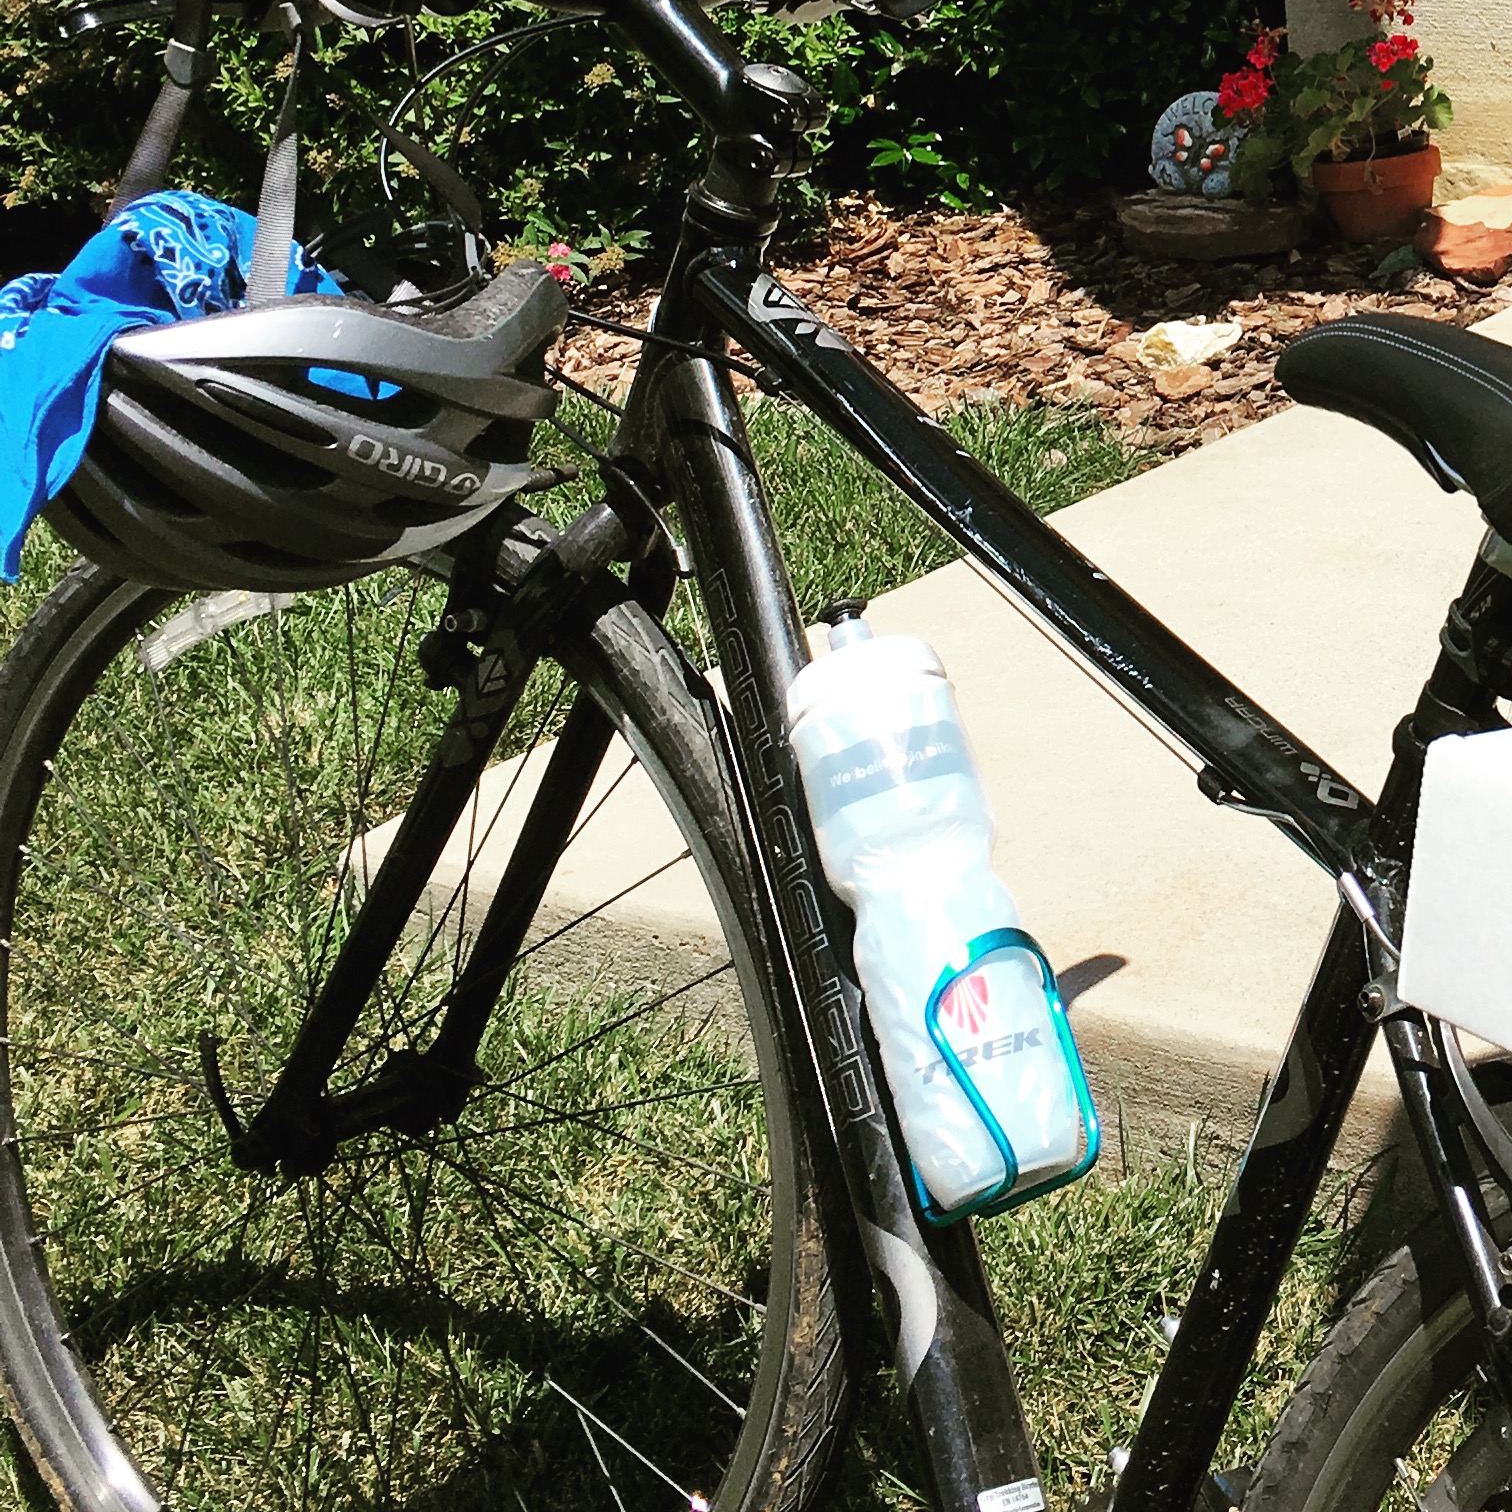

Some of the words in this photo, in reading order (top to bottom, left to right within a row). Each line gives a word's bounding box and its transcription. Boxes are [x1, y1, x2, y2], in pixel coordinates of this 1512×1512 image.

[1164, 96, 1214, 122] WELC
[347, 434, 448, 488] GIRO
[829, 771, 852, 788] We
[854, 752, 908, 780] beliee
[925, 741, 957, 758] bik
[706, 568, 784, 801] GARY
[765, 803, 876, 1128] FISHER
[913, 1027, 1044, 1085] TREK
